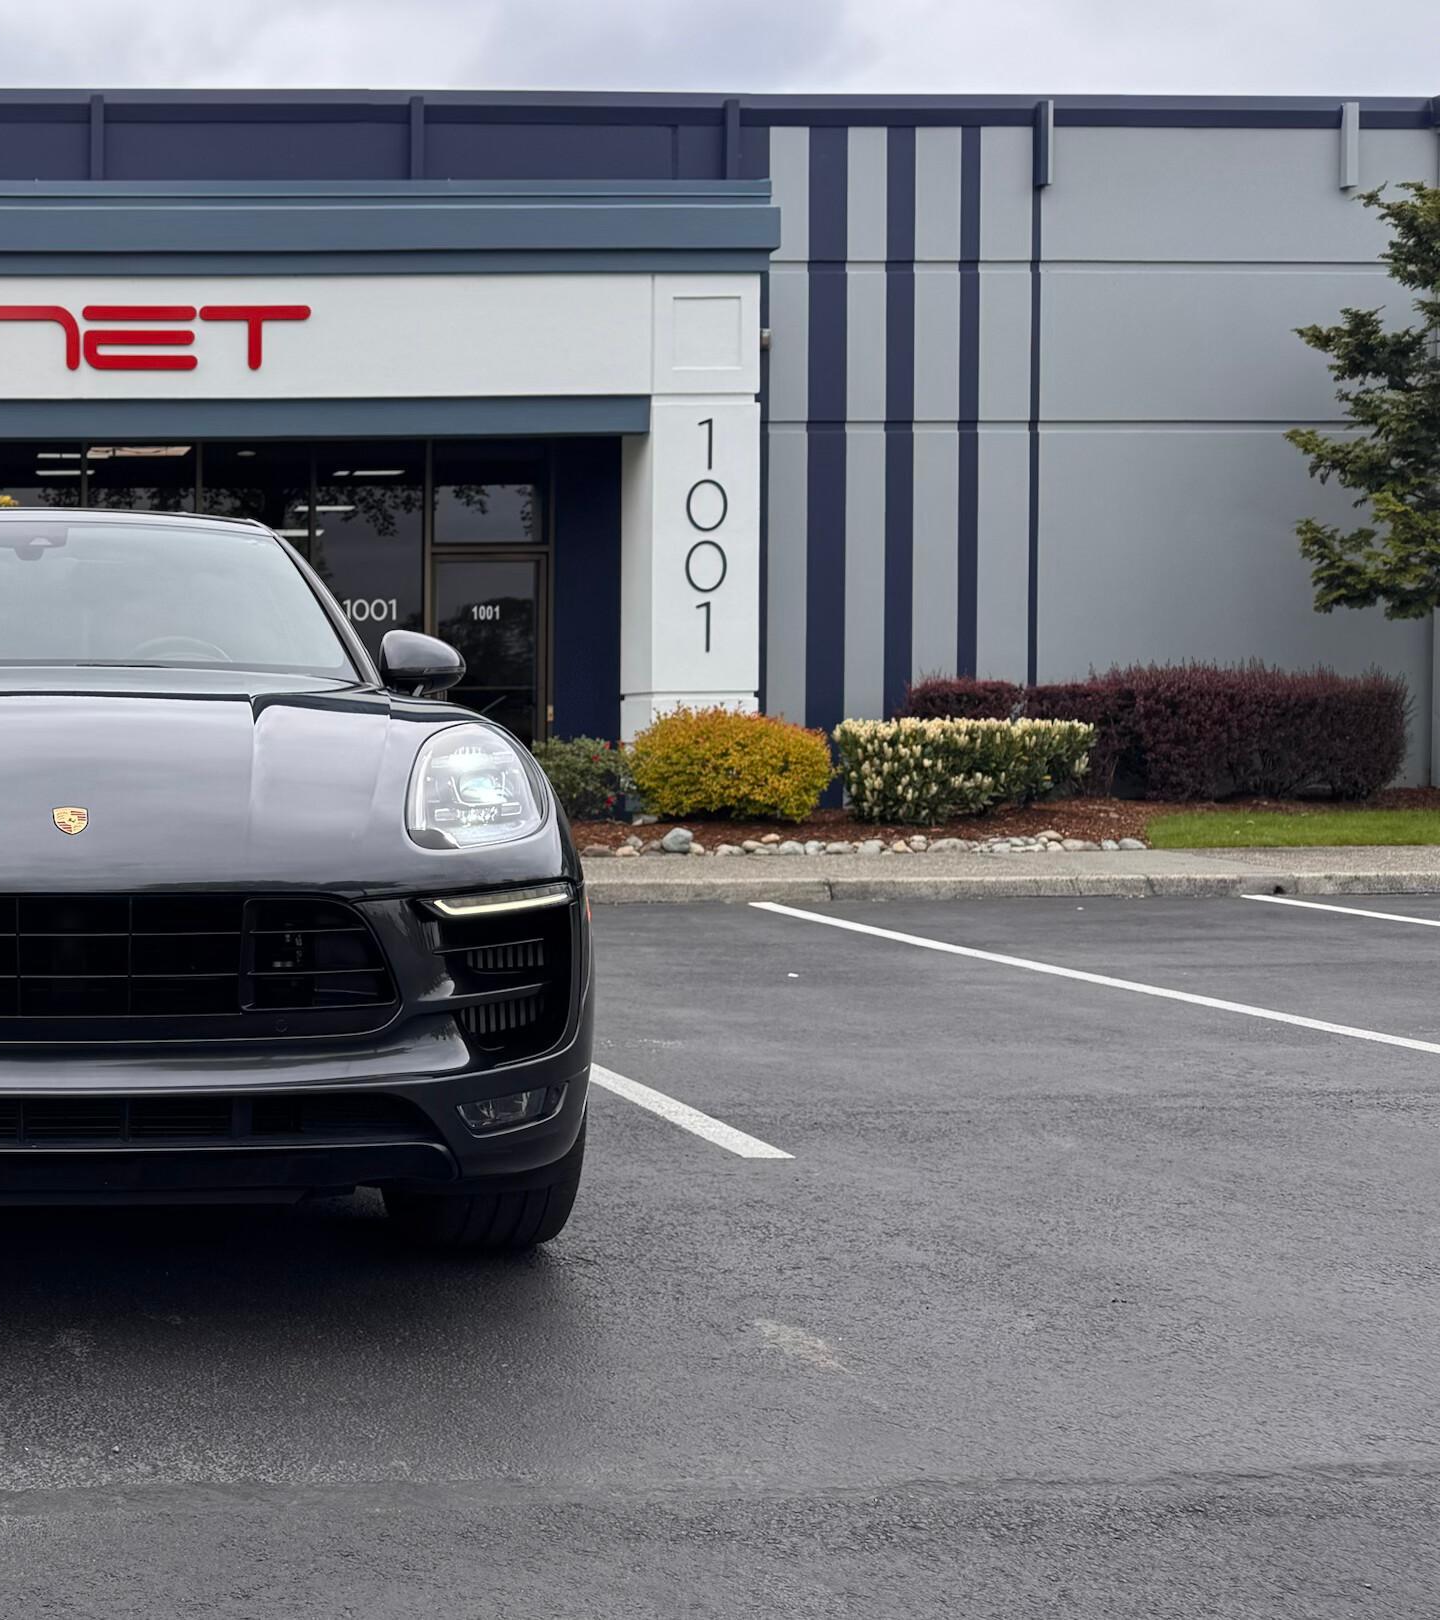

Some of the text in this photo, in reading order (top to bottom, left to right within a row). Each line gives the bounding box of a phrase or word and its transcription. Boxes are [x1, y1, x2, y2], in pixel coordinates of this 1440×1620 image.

[685, 418, 728, 653] 1001
[342, 598, 397, 621] 1001
[471, 605, 500, 621] 1001
